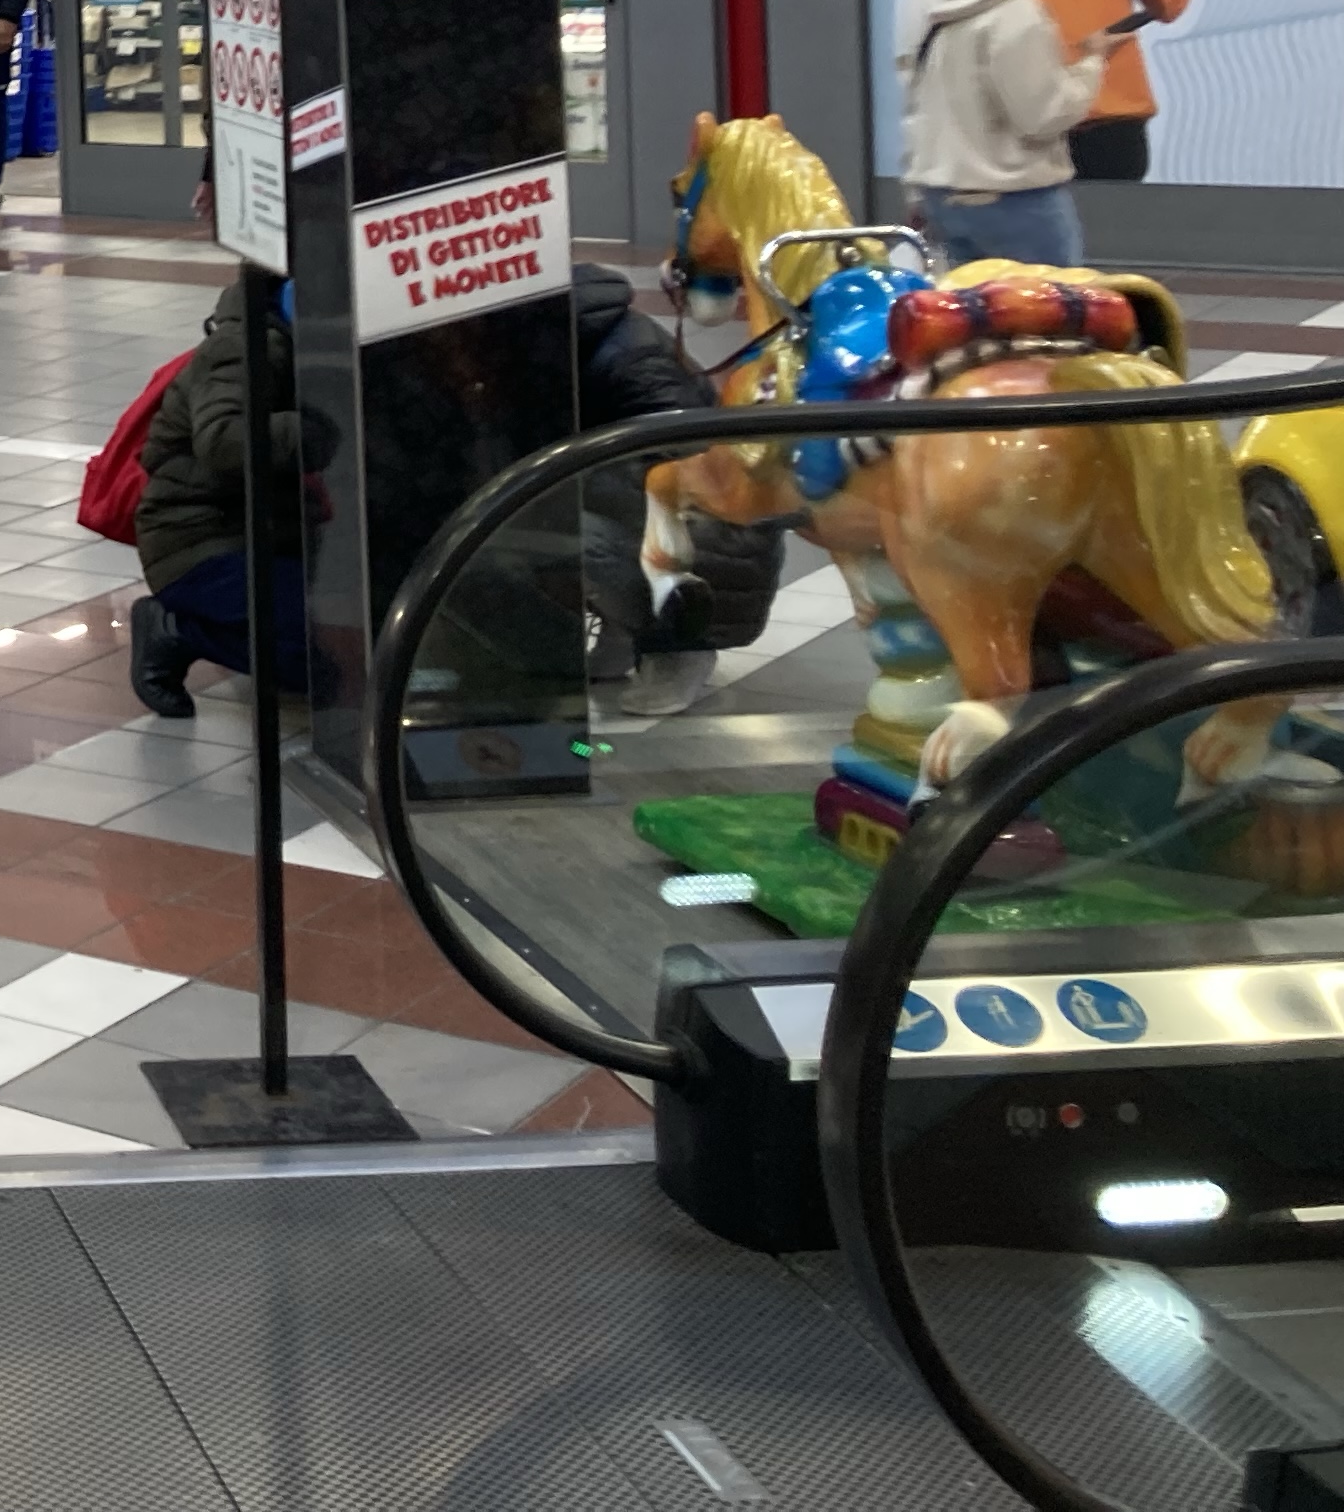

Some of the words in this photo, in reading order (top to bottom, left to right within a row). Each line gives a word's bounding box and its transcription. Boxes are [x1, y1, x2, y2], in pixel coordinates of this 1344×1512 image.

[364, 177, 552, 248] DISTRIBUTORE
[389, 248, 419, 276] DI
[428, 215, 543, 266] GETTONI
[408, 281, 426, 307] E
[434, 251, 542, 299] MONETE
